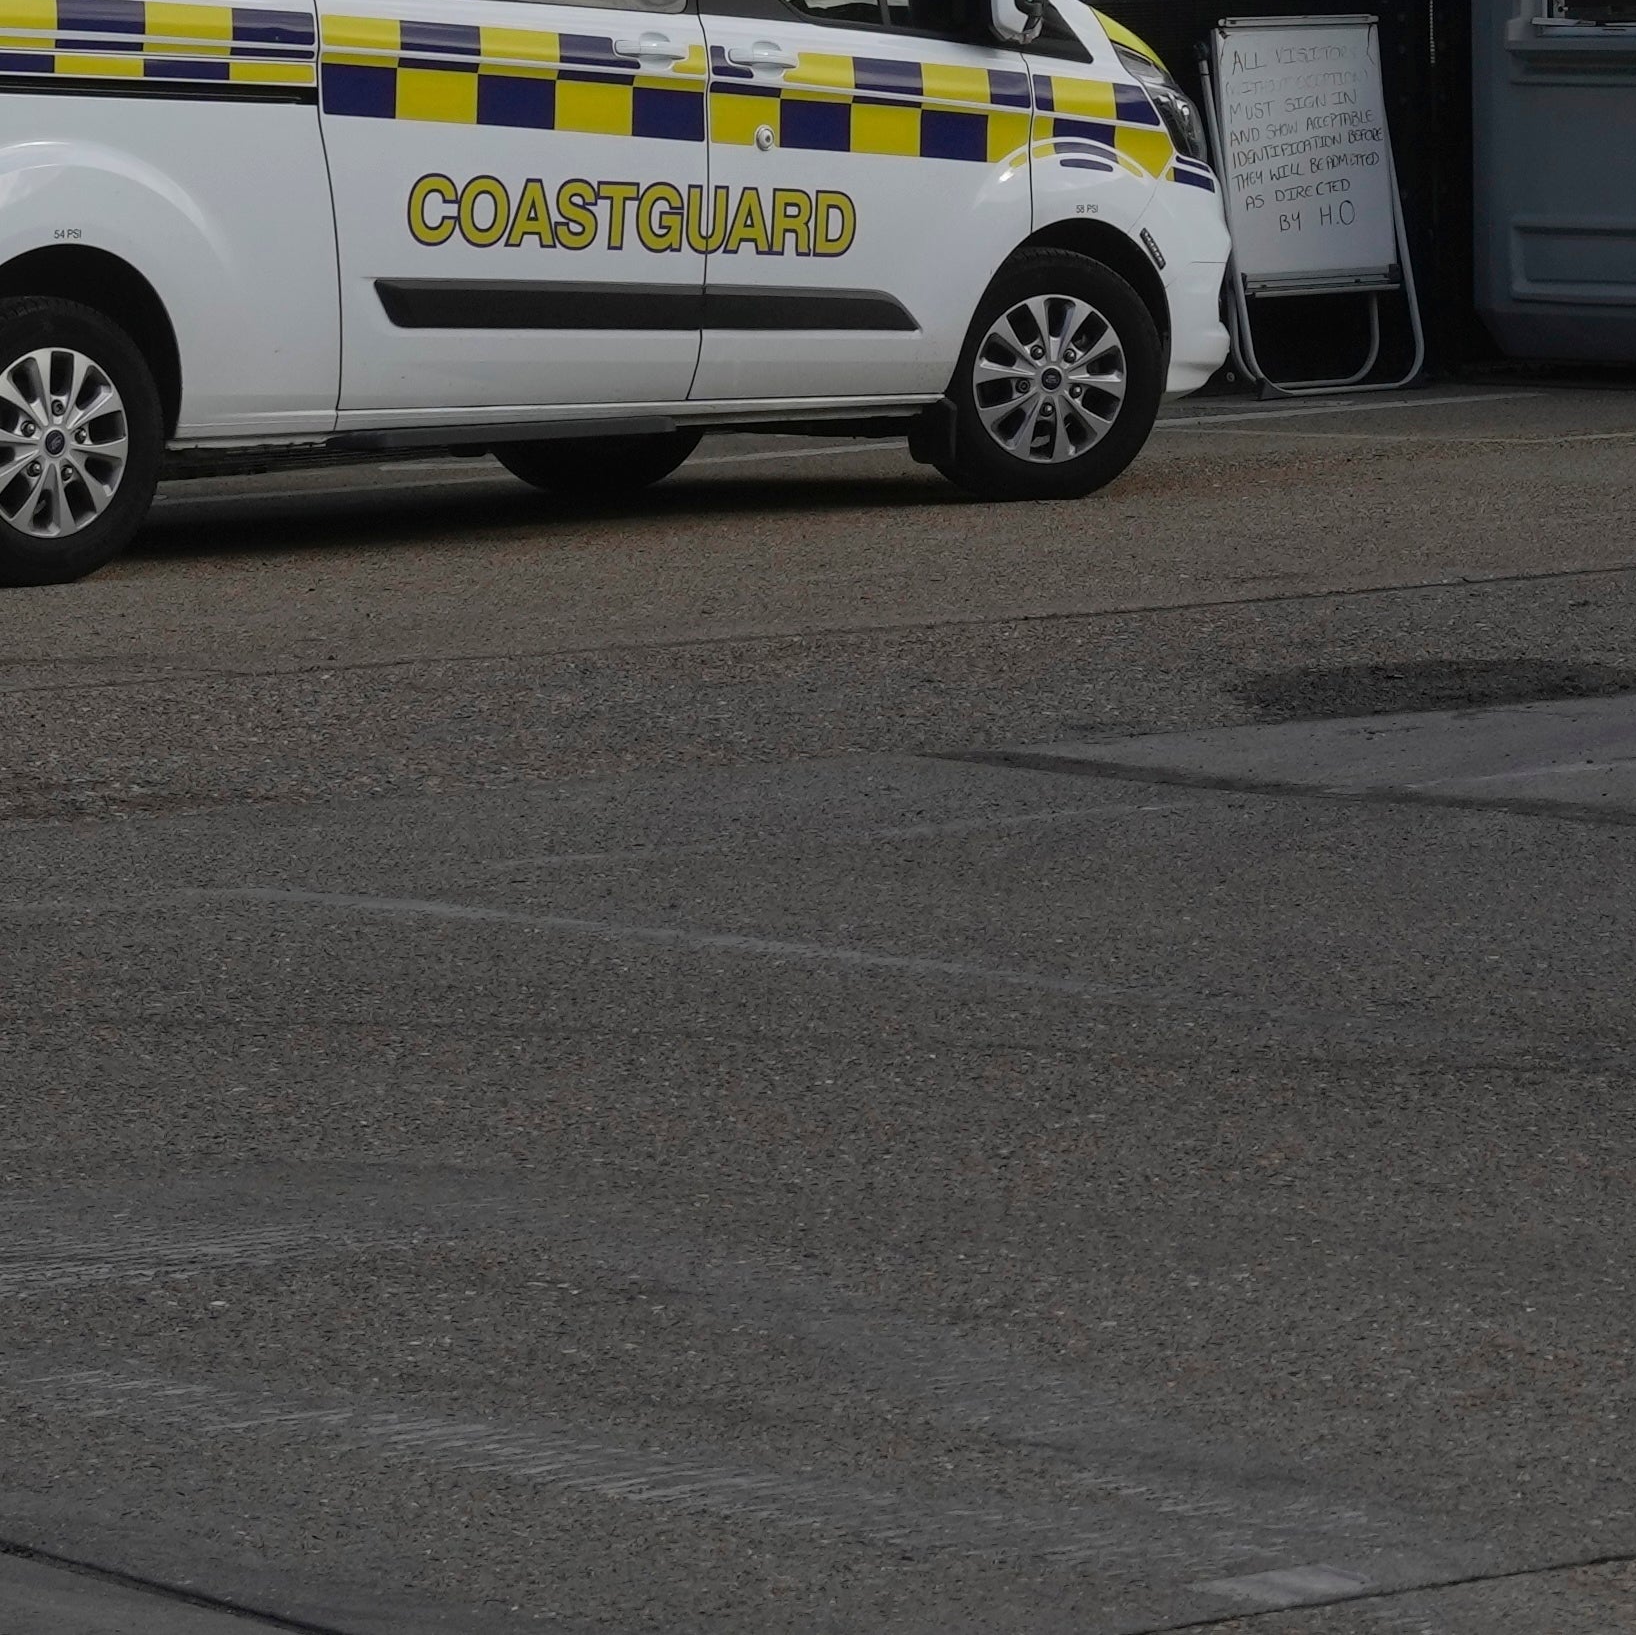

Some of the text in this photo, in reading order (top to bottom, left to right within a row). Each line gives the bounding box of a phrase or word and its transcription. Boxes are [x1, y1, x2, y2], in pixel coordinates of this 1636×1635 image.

[1232, 50, 1267, 75] ALL
[1229, 88, 1357, 124] MUST SIGN IN
[1230, 109, 1374, 147] AND SHOW ACCEPTABLE
[1232, 128, 1383, 169] IDENTIFICATION BEFORE
[1232, 170, 1263, 192] THEY
[1269, 163, 1305, 181] WILL
[1087, 203, 1098, 214] PSI
[1245, 178, 1351, 211] AS DIRECTED
[407, 172, 857, 258] COASTGUARD
[1279, 212, 1301, 232] BY
[54, 228, 82, 239] 54 PSI
